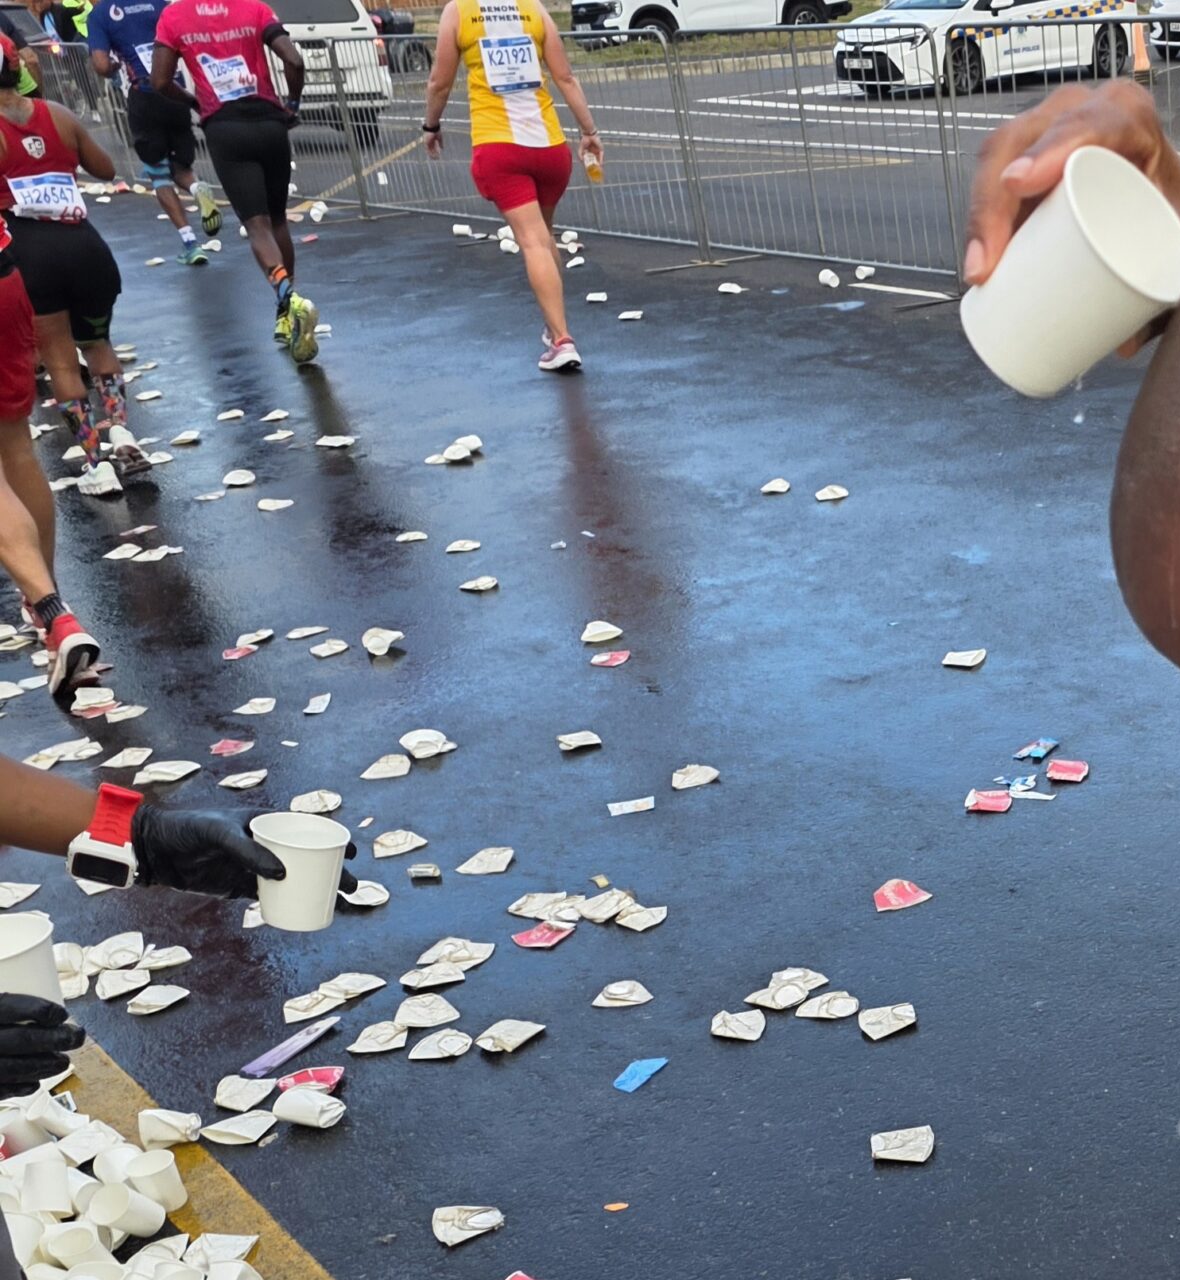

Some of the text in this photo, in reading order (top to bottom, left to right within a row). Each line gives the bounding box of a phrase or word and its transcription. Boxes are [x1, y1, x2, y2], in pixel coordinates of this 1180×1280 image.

[471, 14, 531, 23] NORTHERNS
[180, 26, 257, 44] TEAM VITALITY
[488, 46, 532, 66] K21921
[20, 186, 74, 204] H26547
